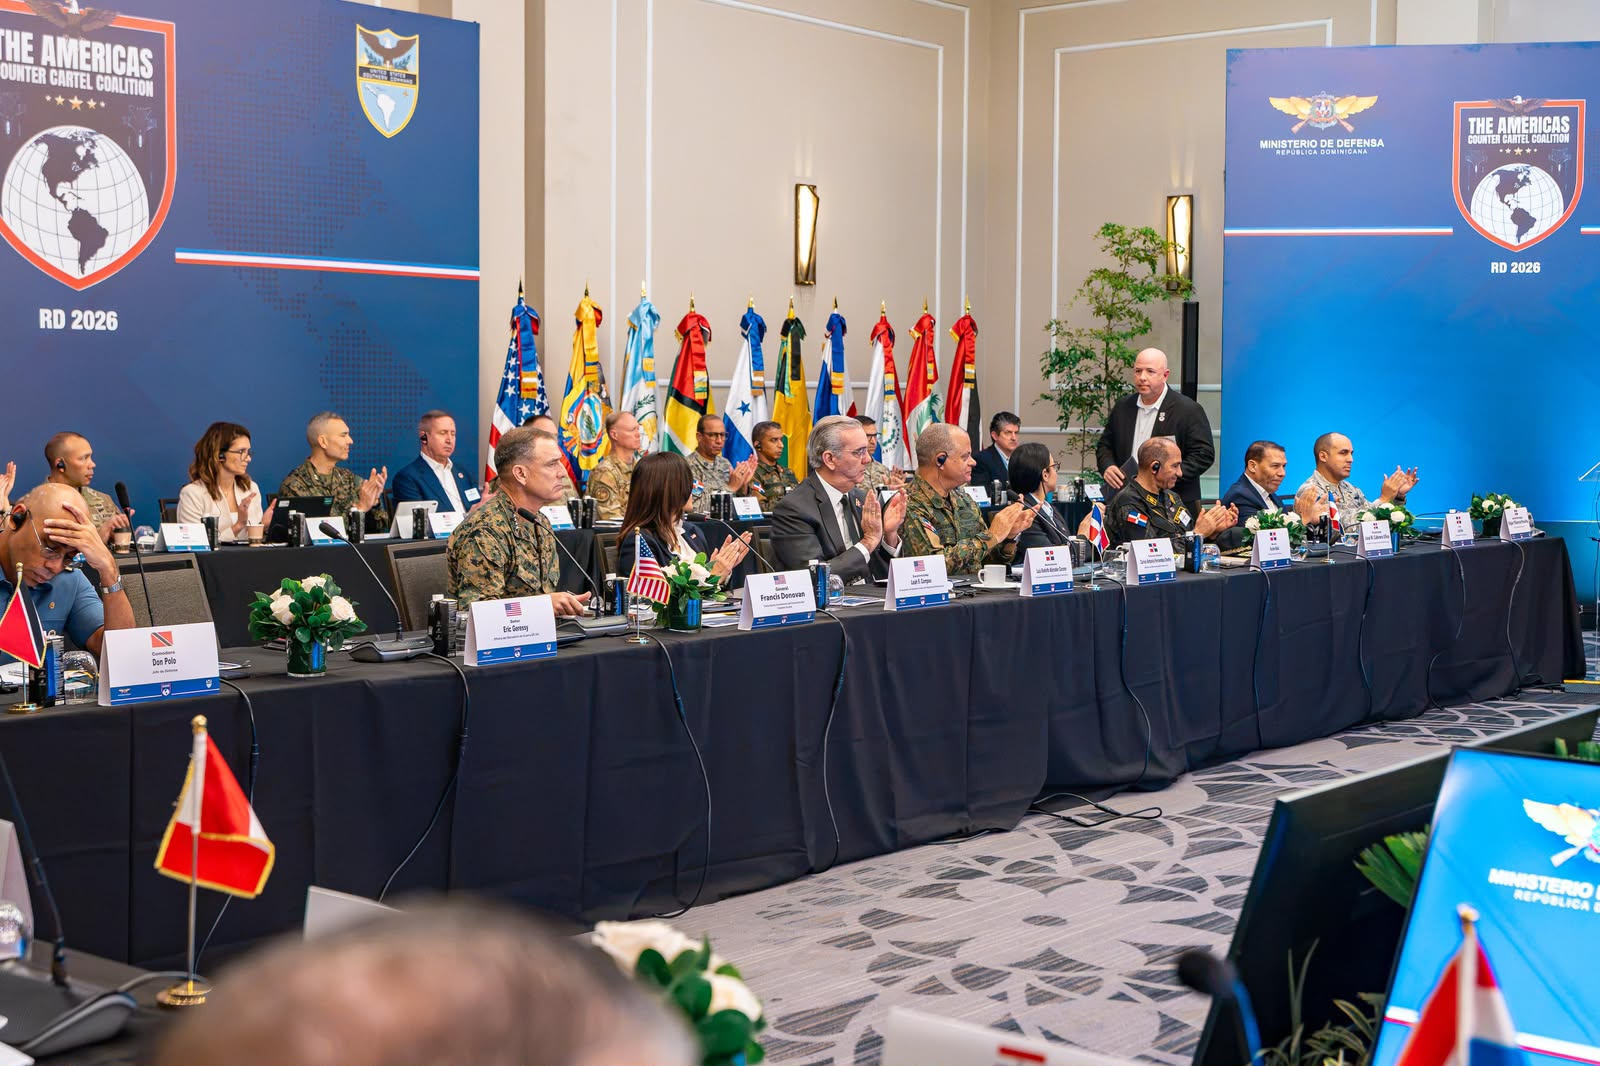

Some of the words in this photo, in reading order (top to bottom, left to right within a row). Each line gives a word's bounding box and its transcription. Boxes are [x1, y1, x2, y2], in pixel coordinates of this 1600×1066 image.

[41, 34, 154, 79] AMERICAS
[0, 62, 47, 85] OUNTER
[50, 69, 94, 91] CARTEL
[96, 74, 154, 98] COALITION
[1468, 117, 1494, 135] THE
[1497, 115, 1570, 134] AMERICAS
[1259, 139, 1318, 149] MINISTERIO
[1320, 139, 1334, 148] DE
[1336, 138, 1385, 148] DEFENSA
[1468, 134, 1500, 145] COUNTER
[1502, 134, 1530, 144] CARTEL
[1531, 133, 1570, 144] COALITION
[1490, 261, 1508, 274] RD
[1510, 261, 1541, 274] 2026
[39, 308, 66, 329] RD
[71, 309, 119, 331] 2026
[760, 593, 781, 602] Francis
[781, 591, 806, 599] Donovan
[503, 625, 512, 633] Eric
[152, 658, 163, 666] Don
[164, 657, 177, 665] Polo
[1488, 868, 1595, 899] MINISTERIO
